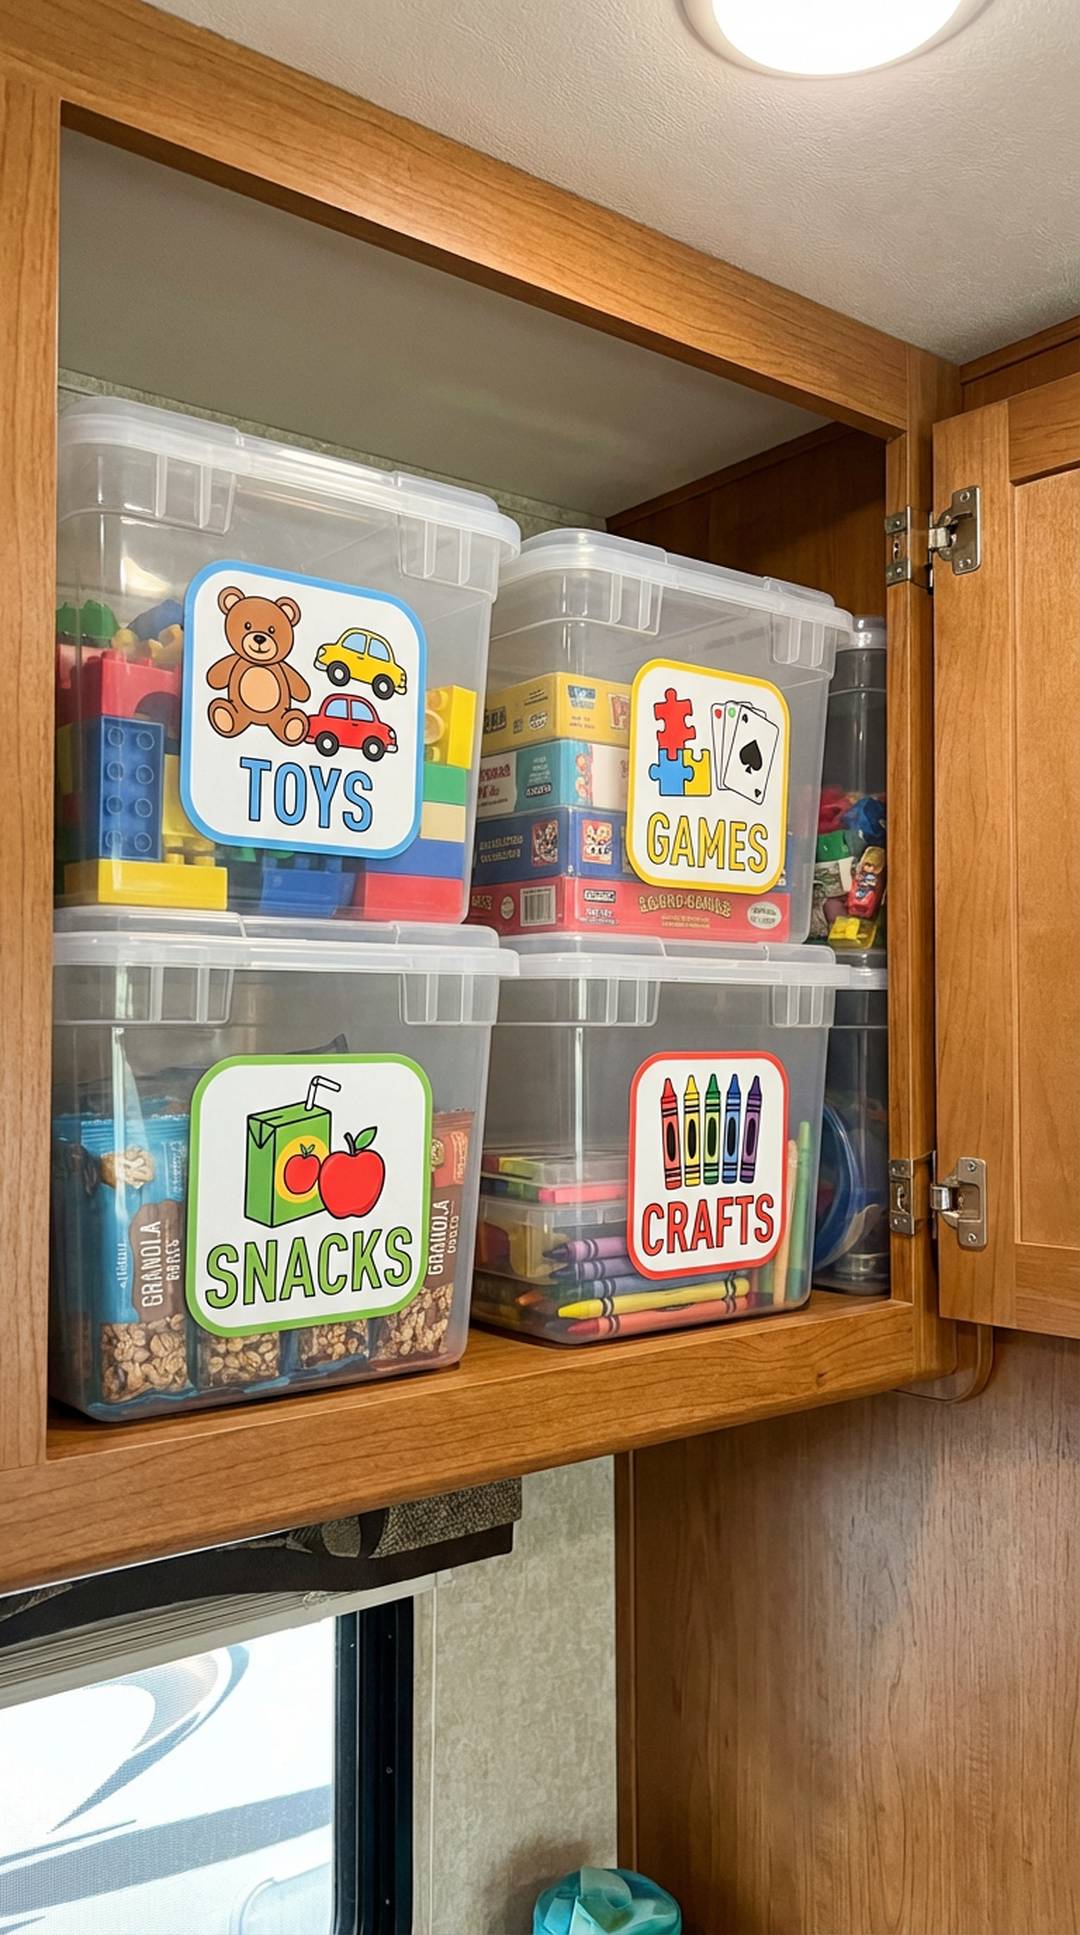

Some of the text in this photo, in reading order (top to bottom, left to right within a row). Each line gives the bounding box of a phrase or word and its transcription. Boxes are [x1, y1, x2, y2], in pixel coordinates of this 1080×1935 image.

[239, 756, 374, 833] TOYS
[646, 811, 769, 874] GAMES
[641, 1193, 775, 1257] CRAFTS
[141, 1221, 163, 1307] GRANOLA
[204, 1226, 413, 1309] SNACKS
